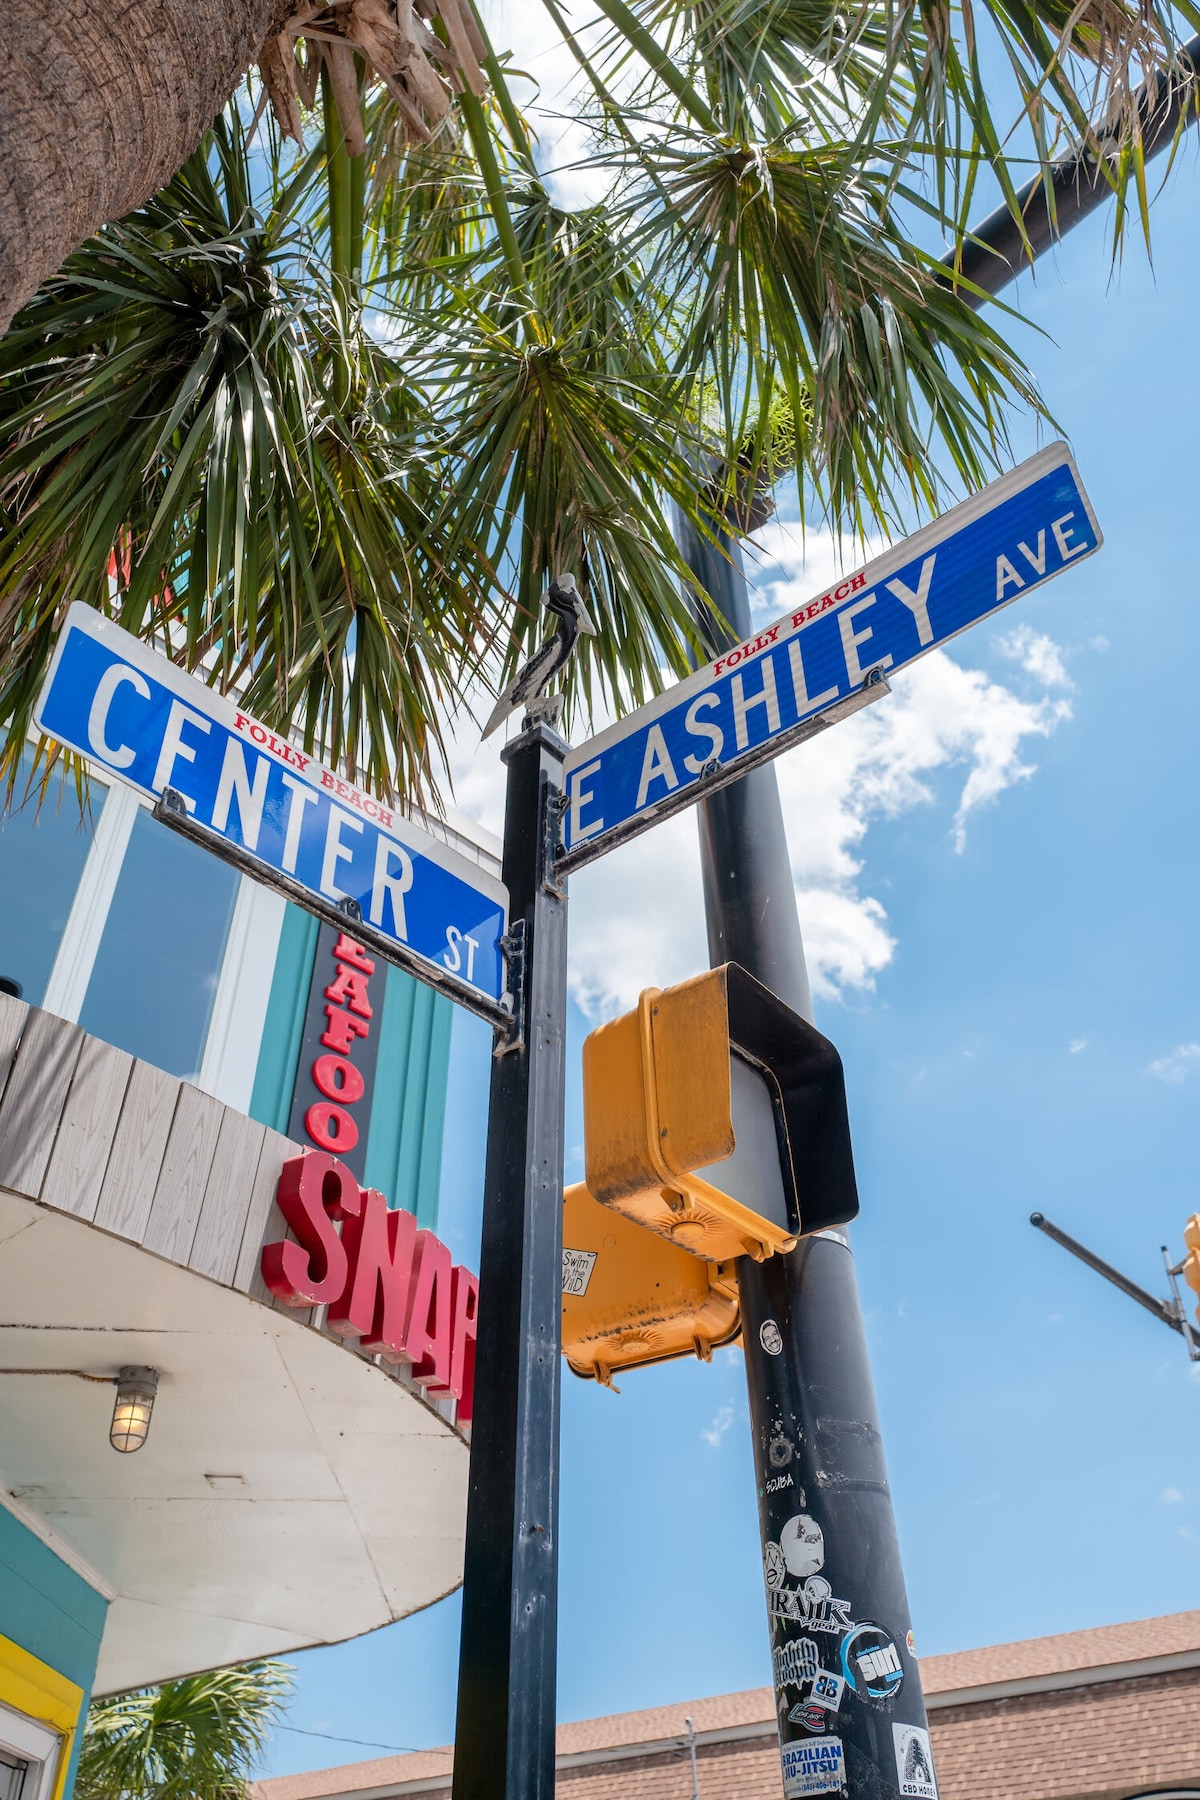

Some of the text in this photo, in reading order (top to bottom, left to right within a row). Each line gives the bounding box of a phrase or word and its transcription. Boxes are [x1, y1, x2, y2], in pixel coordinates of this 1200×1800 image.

[713, 571, 867, 677] FOLLY BEACH
[570, 510, 1089, 848] E ASHLEY AVE
[232, 711, 395, 829] FOLLY BEACH
[86, 662, 481, 983] CENTER ST
[562, 1251, 589, 1269] Swim
[572, 1268, 586, 1278] the
[855, 1642, 902, 1682] sun
[782, 1745, 842, 1767] BRAZILIAN
[785, 1759, 839, 1780] JIU-JITSU
[902, 1784, 918, 1794] CBD
